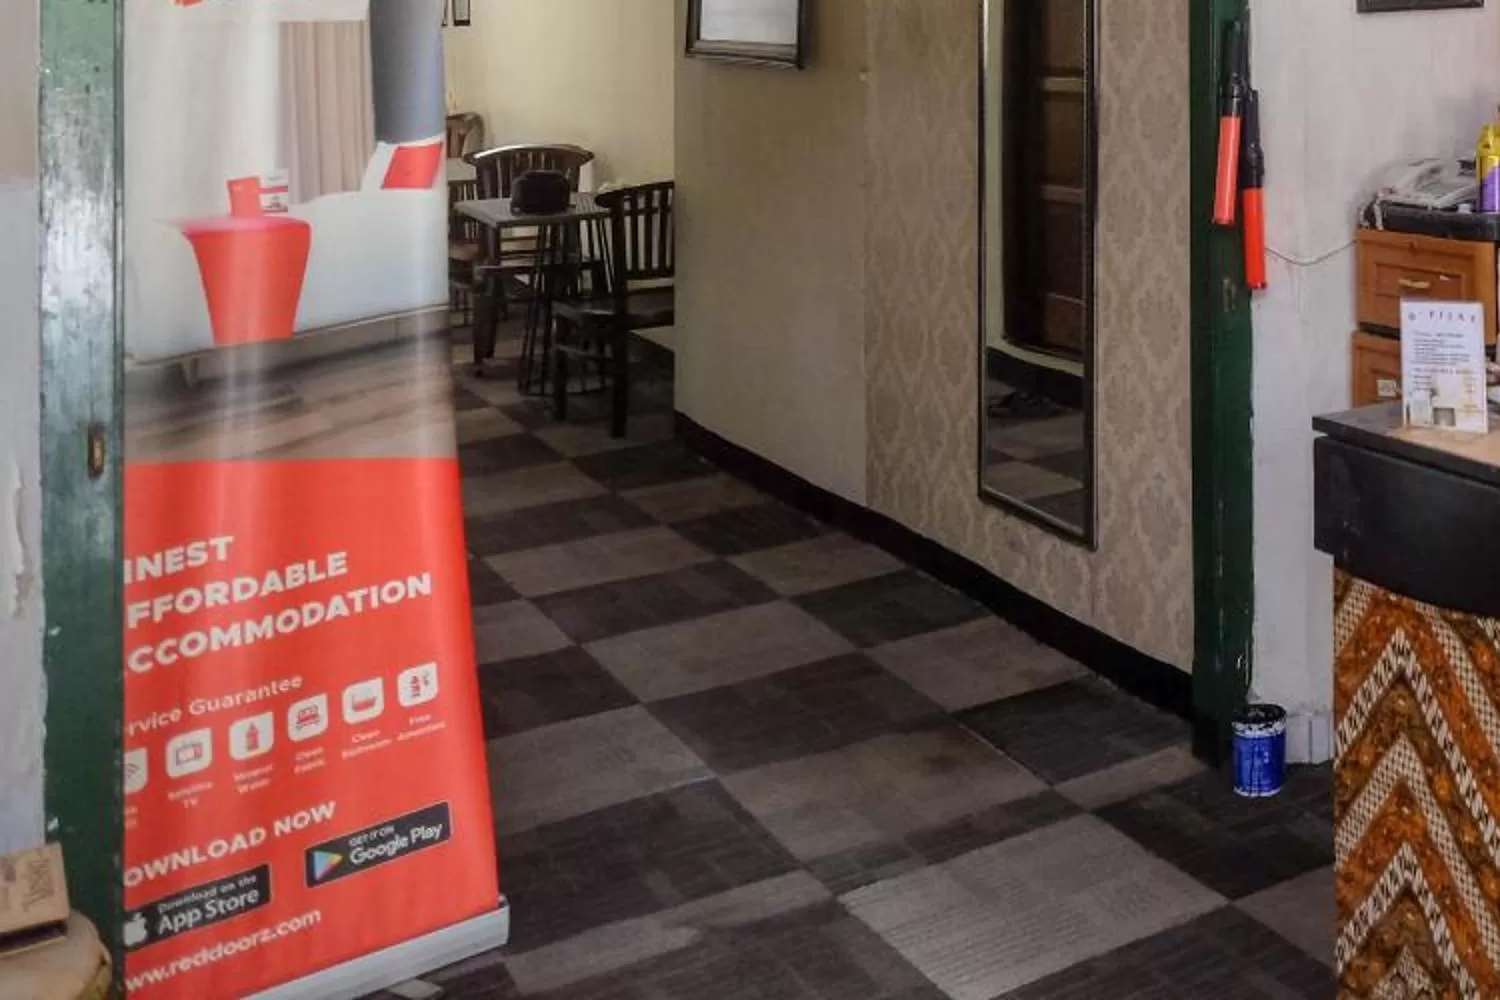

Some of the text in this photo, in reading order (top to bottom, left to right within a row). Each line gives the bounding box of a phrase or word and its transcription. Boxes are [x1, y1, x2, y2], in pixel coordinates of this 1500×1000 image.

[127, 552, 347, 629] FFORDABLE
[128, 572, 431, 673] CCOMMODATION
[188, 675, 303, 716] Guarantee
[273, 801, 337, 837] NOW
[349, 823, 443, 865] Google Play
[158, 889, 260, 935] App Store
